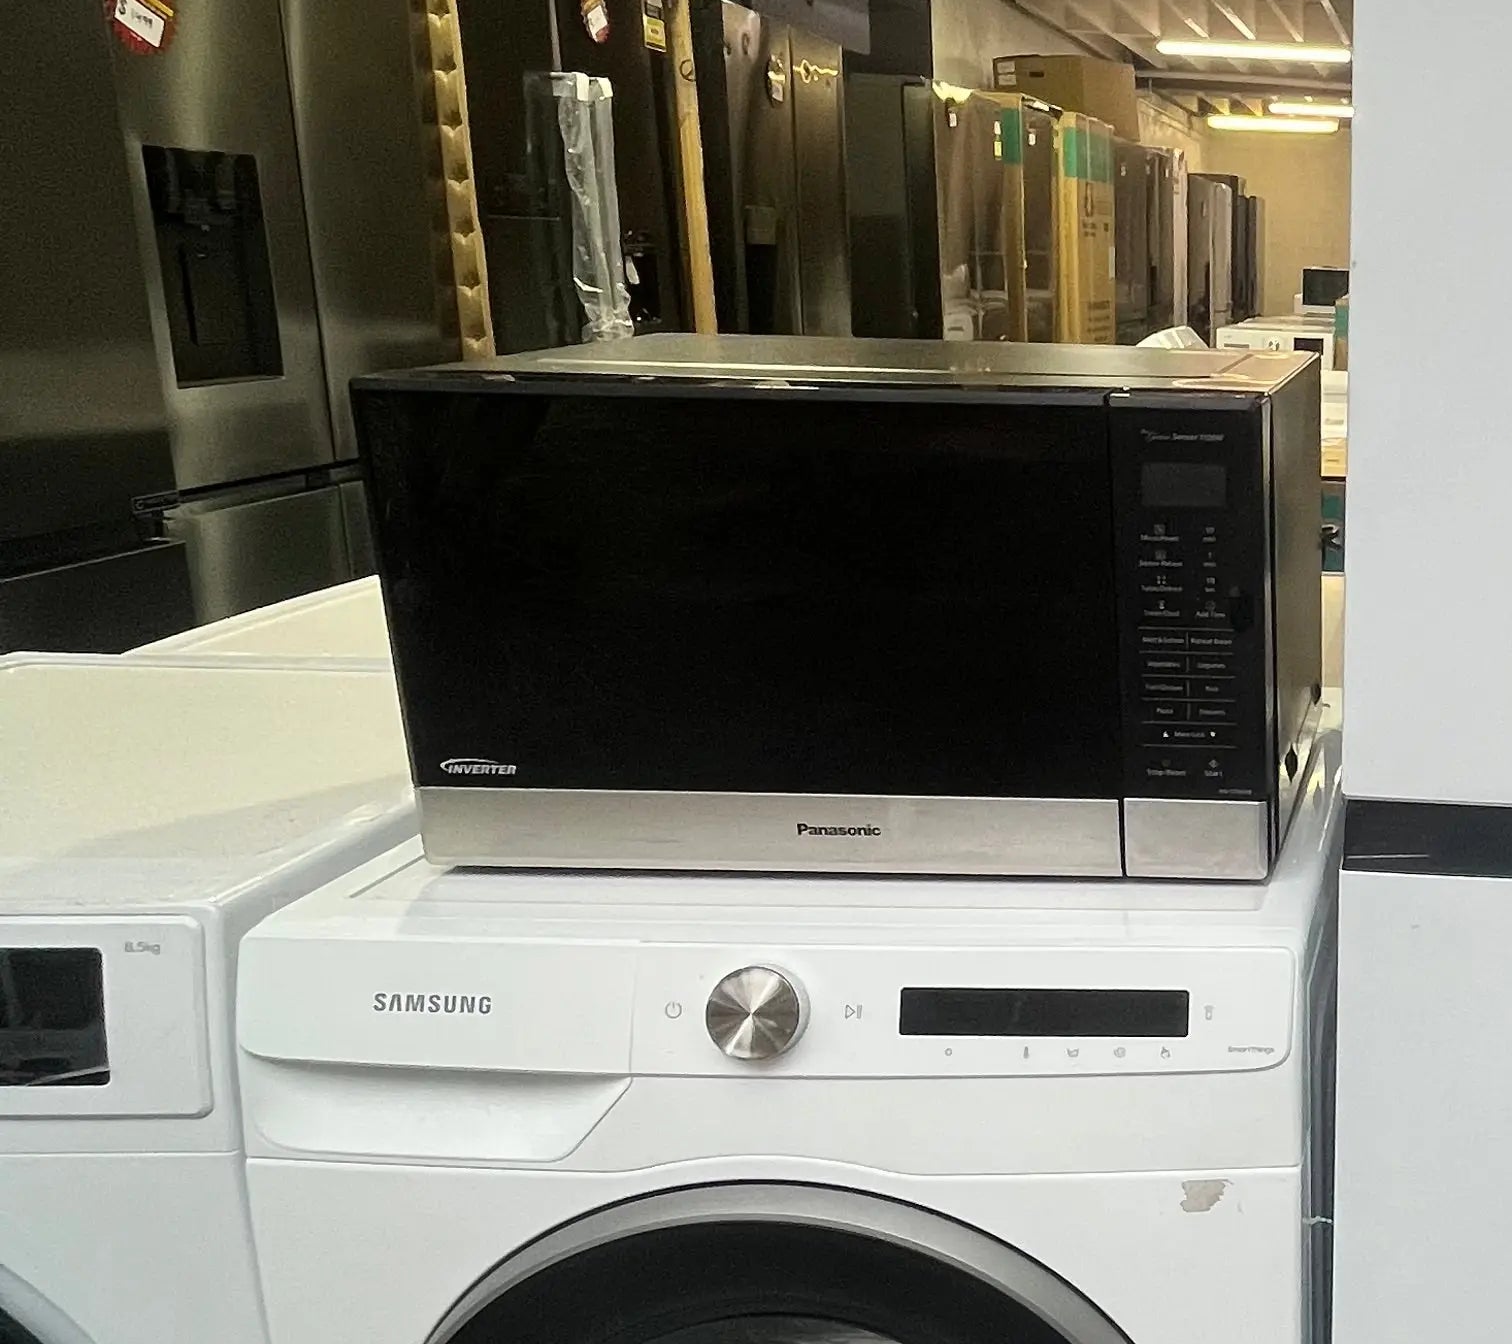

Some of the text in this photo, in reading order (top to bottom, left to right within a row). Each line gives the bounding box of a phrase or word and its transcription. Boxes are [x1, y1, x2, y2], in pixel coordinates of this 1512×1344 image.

[448, 763, 517, 775] INVERTER
[796, 822, 882, 837] Panasonic
[372, 992, 492, 1016] SAMSUNG
